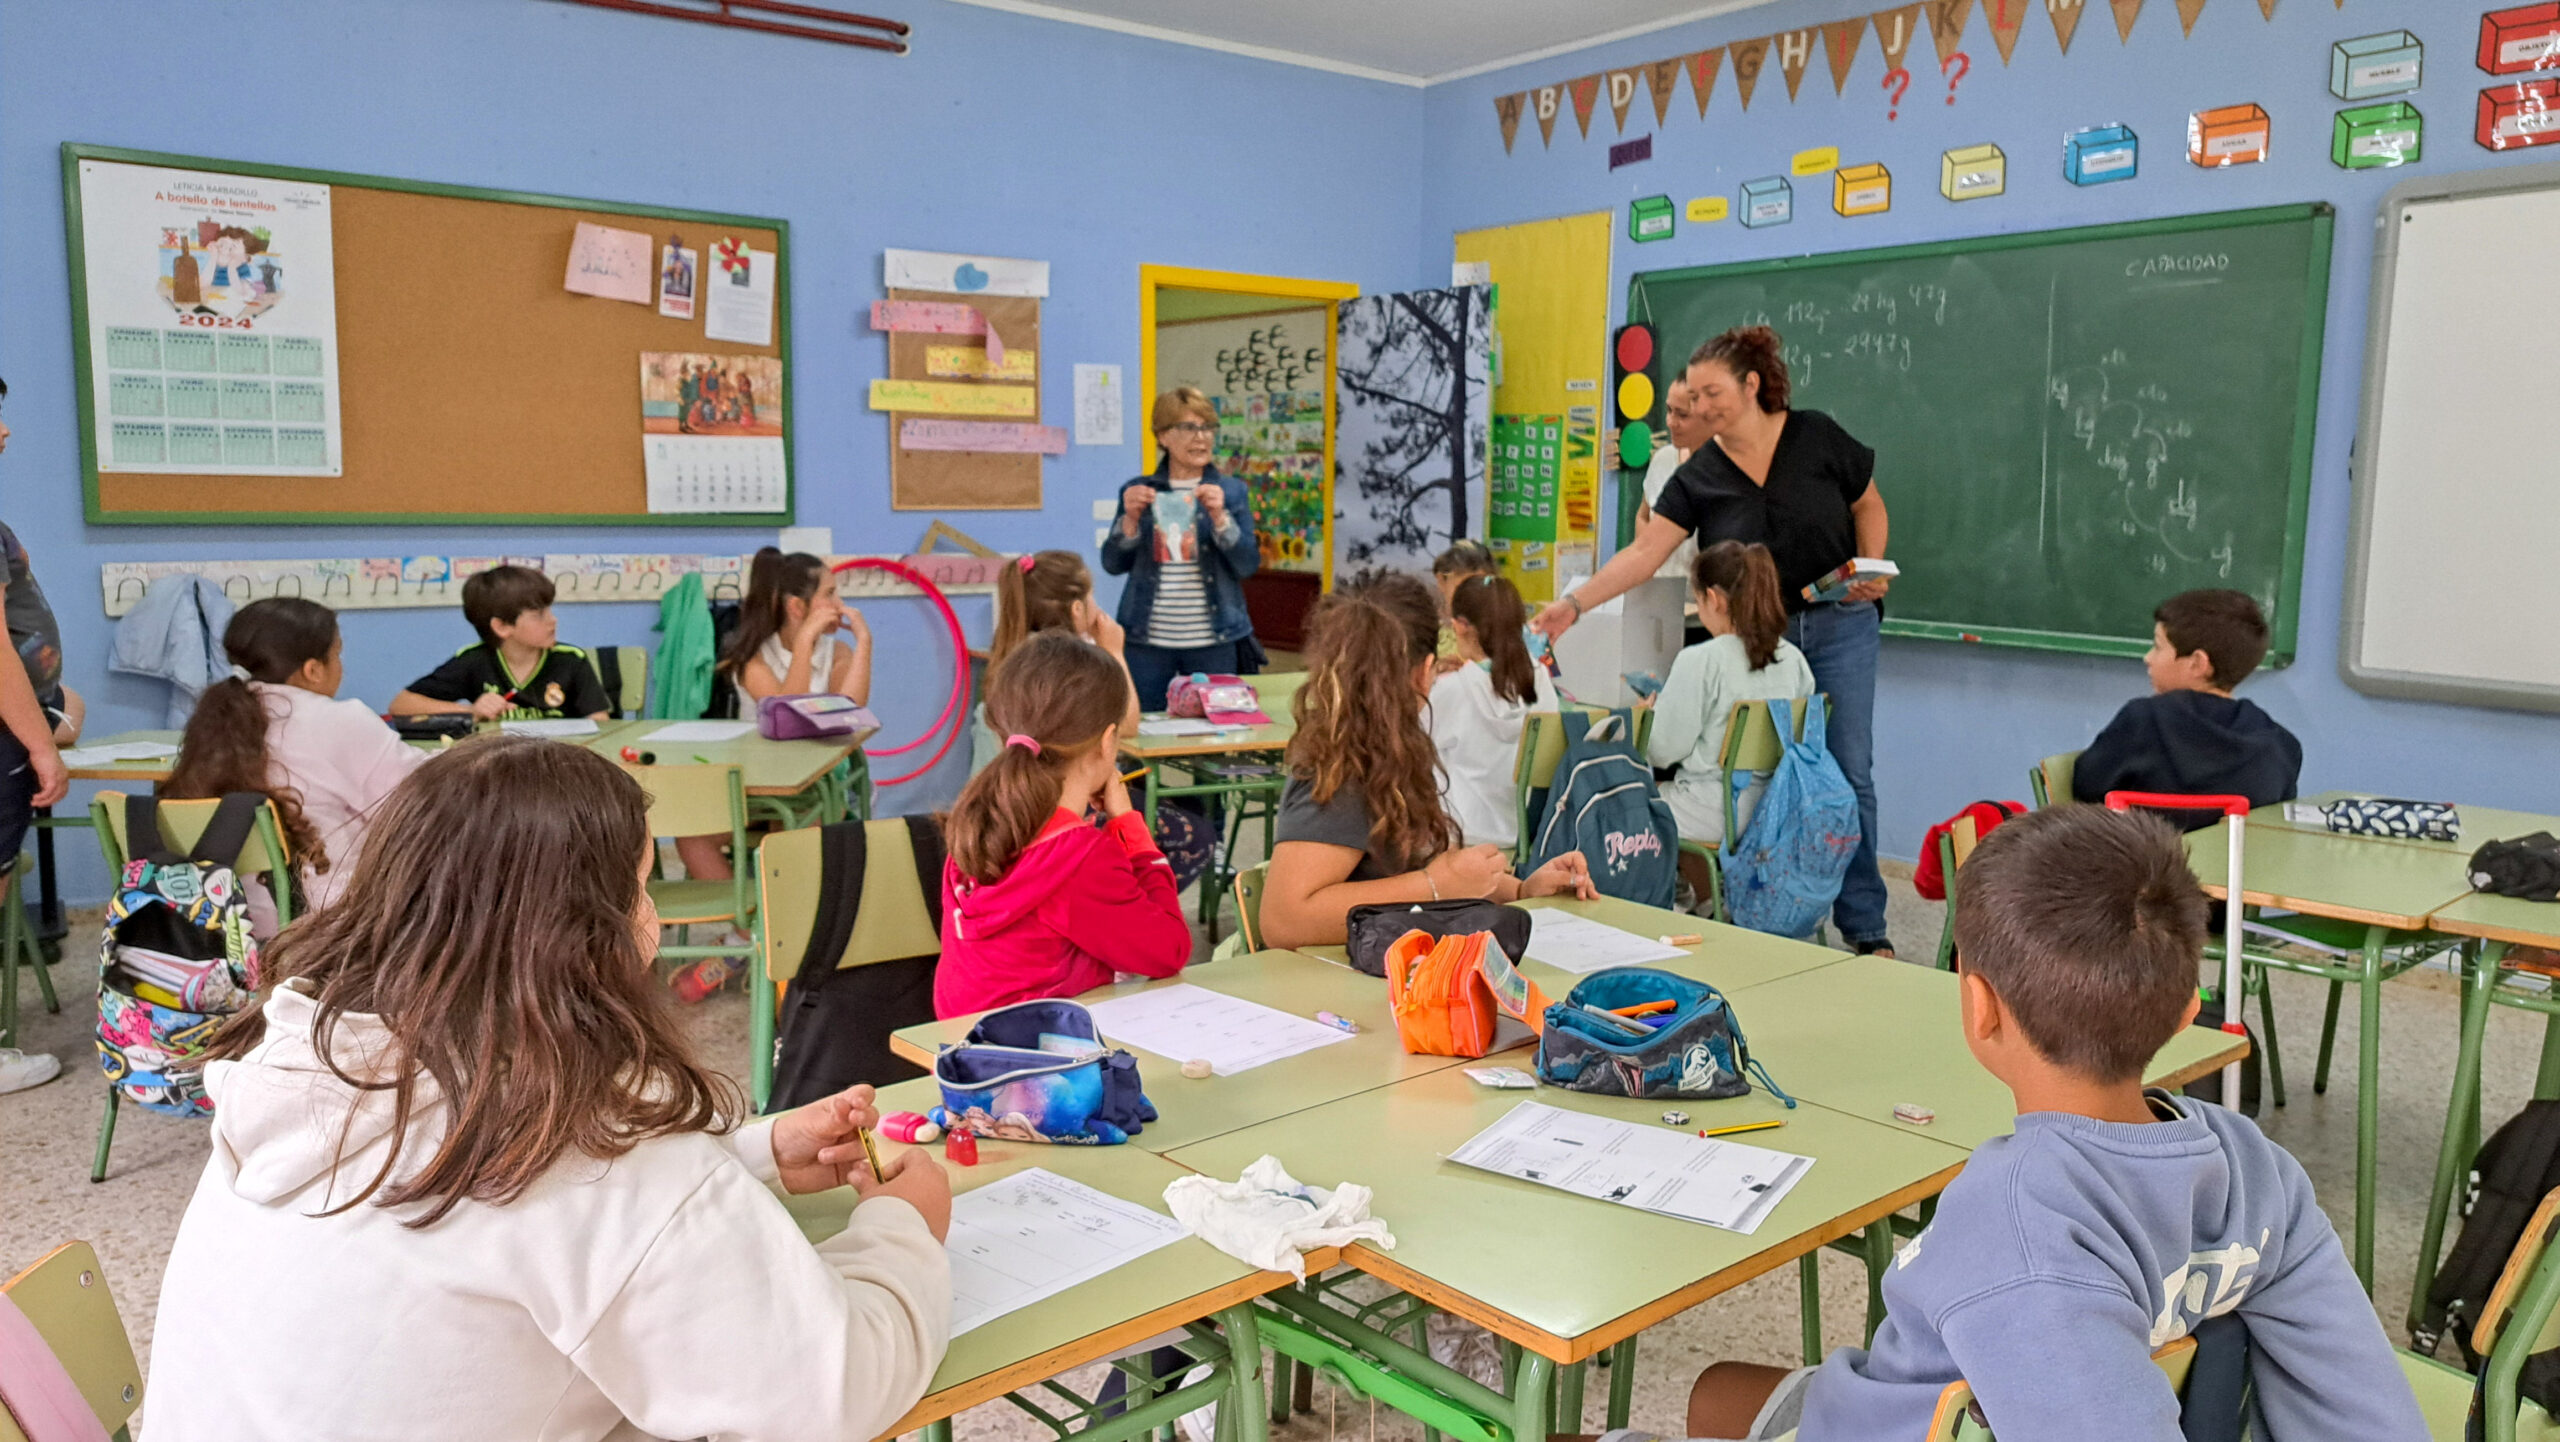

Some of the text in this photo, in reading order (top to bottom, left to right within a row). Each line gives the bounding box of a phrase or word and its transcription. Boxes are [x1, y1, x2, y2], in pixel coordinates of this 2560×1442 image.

[1501, 0, 2014, 124] A B C D E F G H I J K L
[155, 191, 164, 201] A
[211, 197, 226, 207] de
[2125, 253, 2231, 278] CAPACIDAD
[179, 314, 255, 330] 2024
[1604, 827, 1663, 866] Replay
